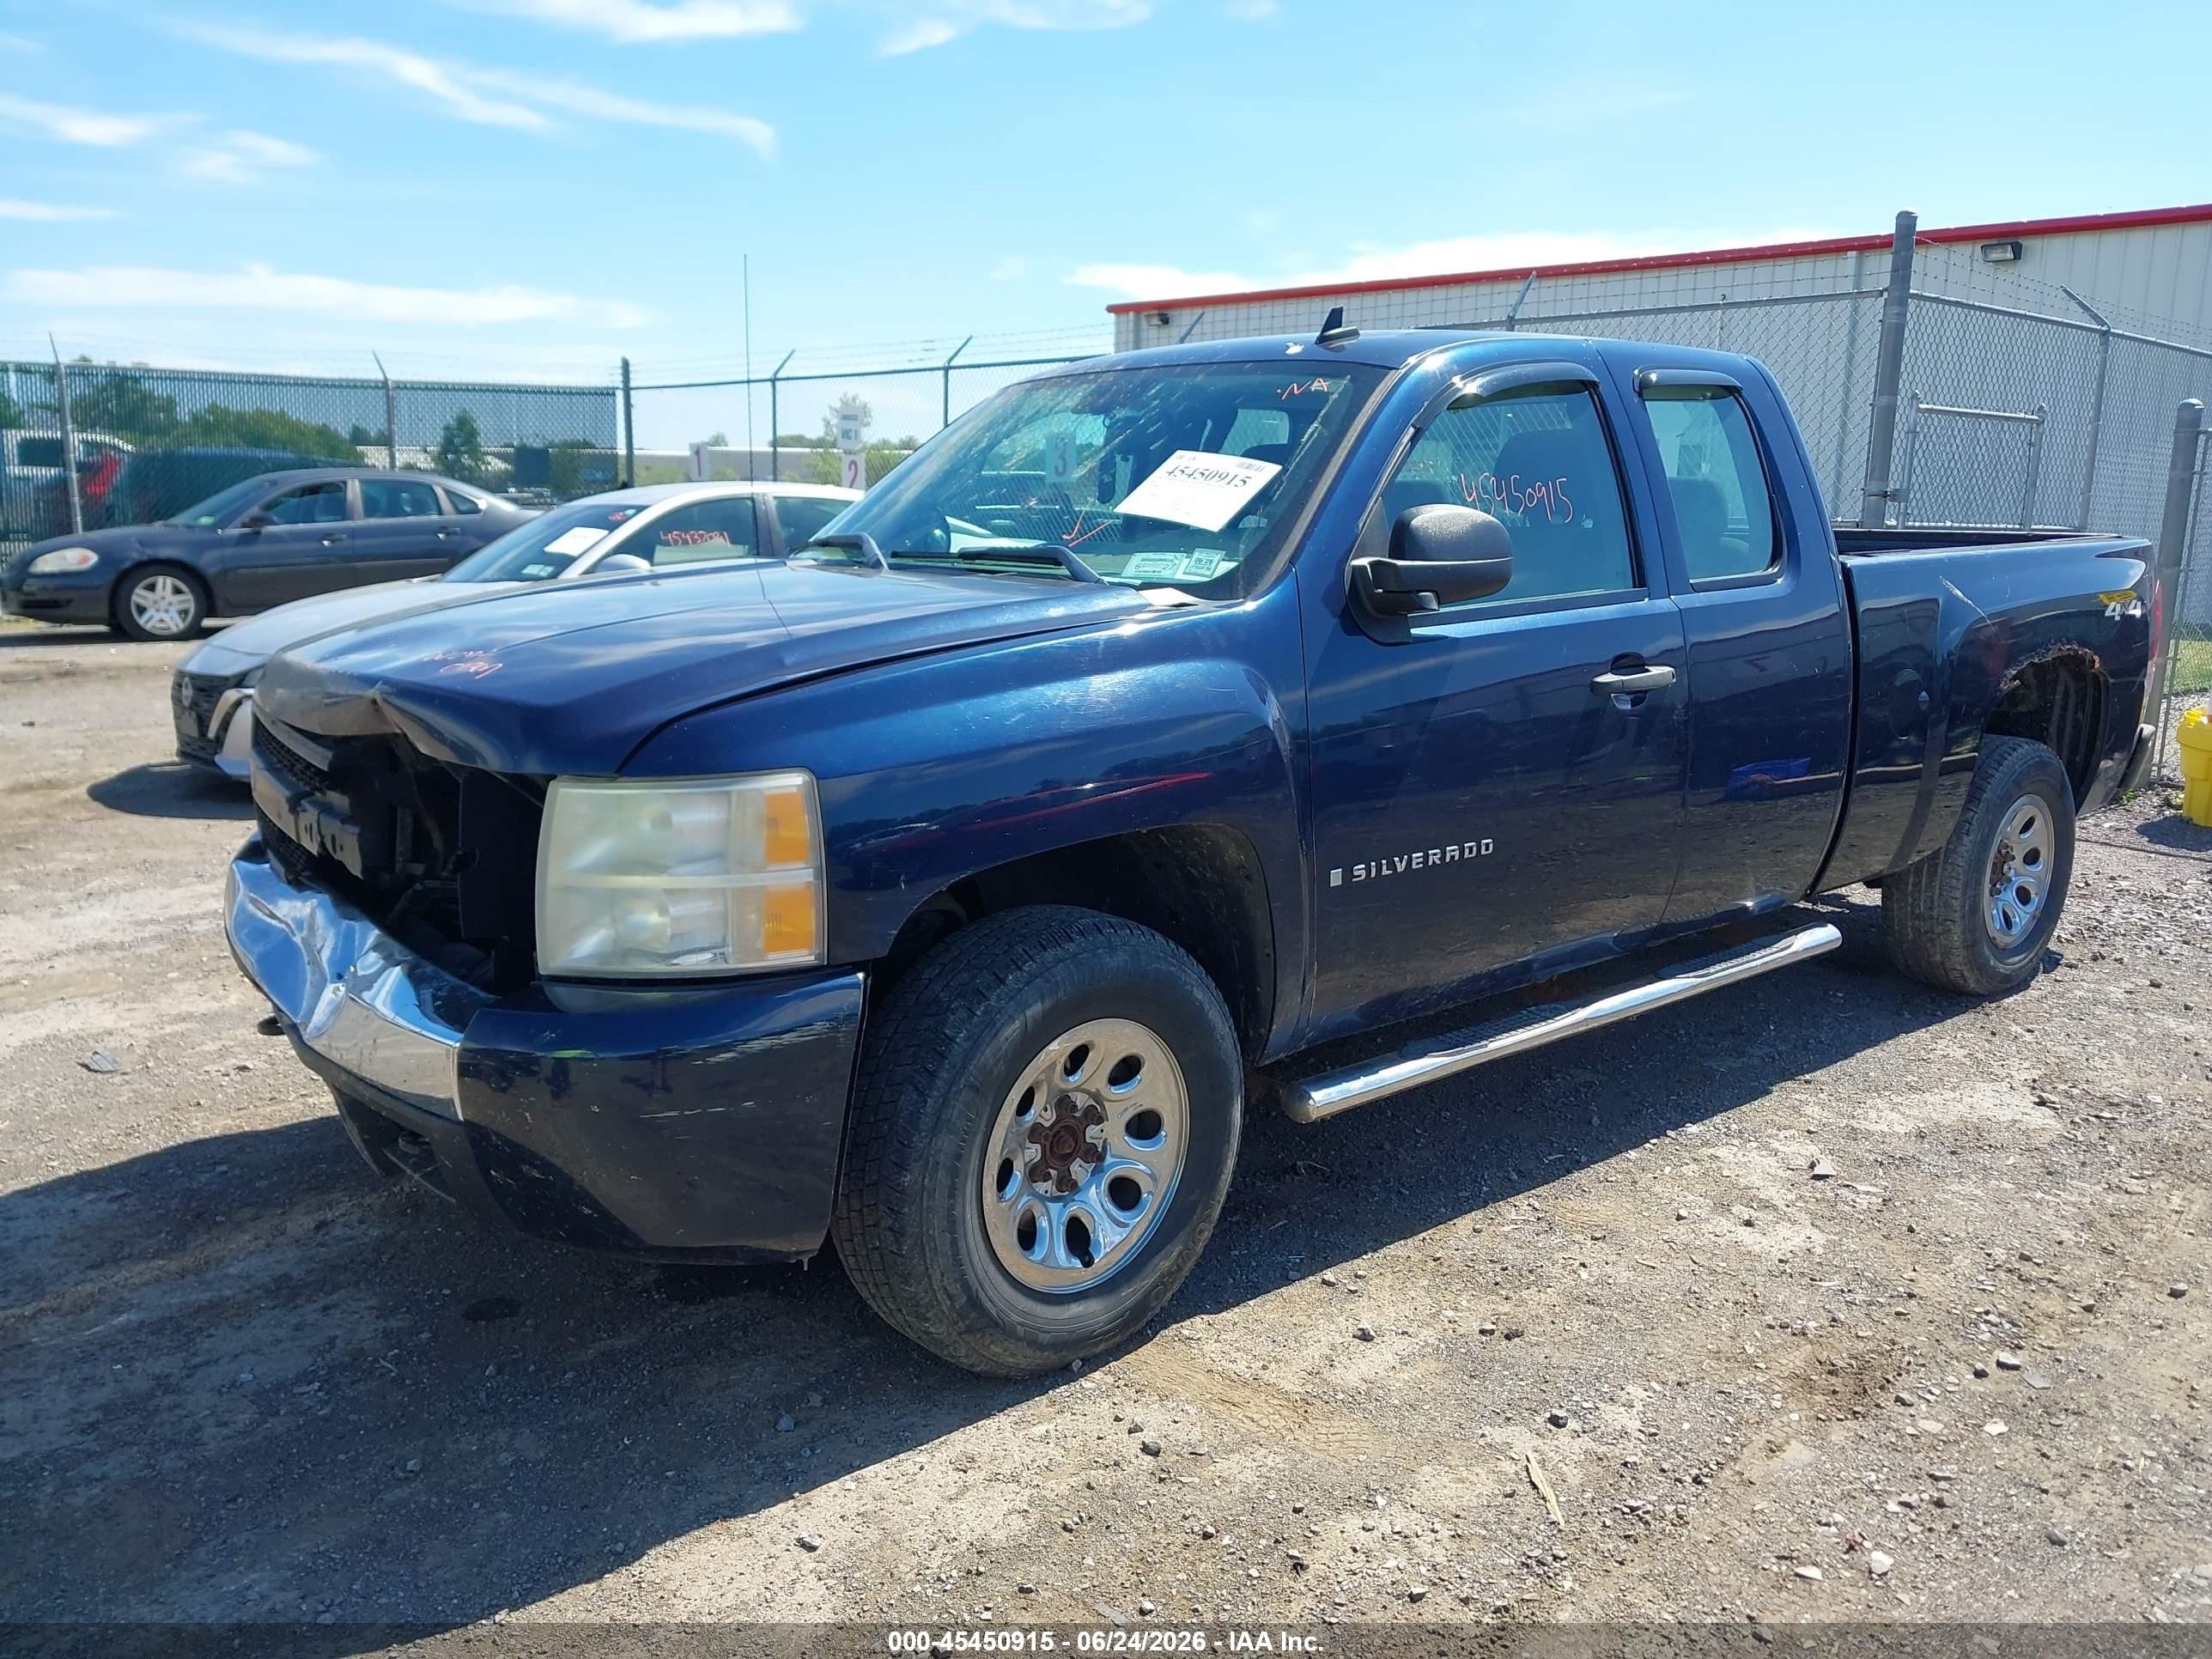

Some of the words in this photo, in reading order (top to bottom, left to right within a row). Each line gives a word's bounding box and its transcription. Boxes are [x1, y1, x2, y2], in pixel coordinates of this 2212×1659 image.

[695, 446, 702, 477] 1
[1166, 465, 1253, 488] 45450915
[1460, 472, 1573, 524] 45450915
[1352, 838, 1494, 882] SILVERADO
